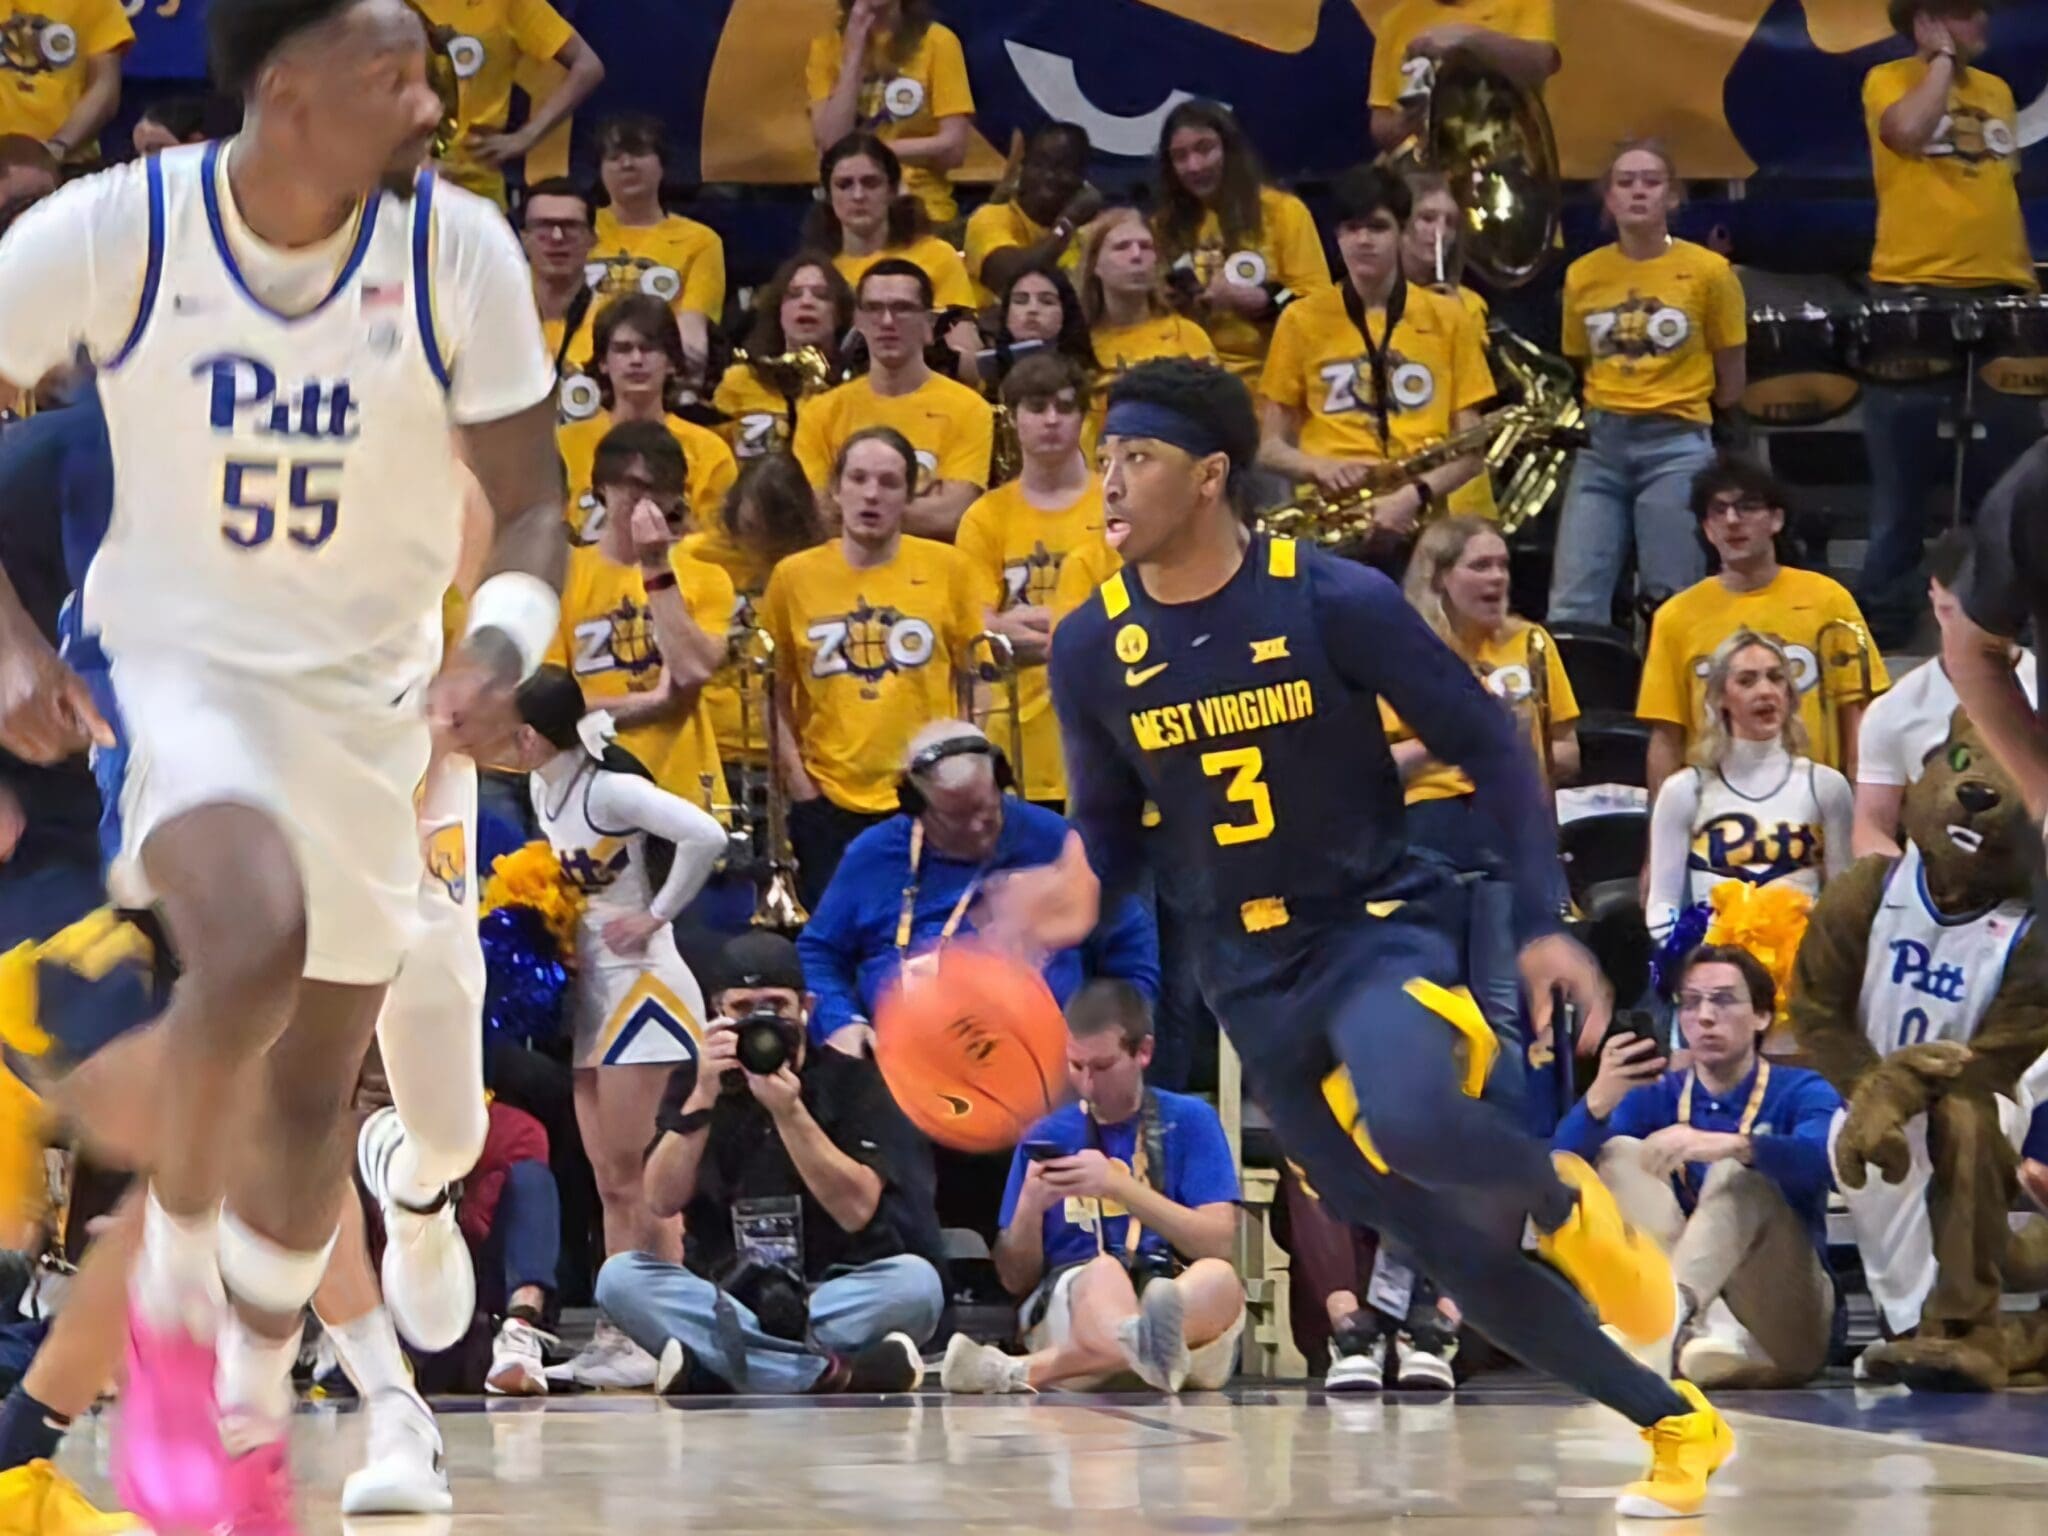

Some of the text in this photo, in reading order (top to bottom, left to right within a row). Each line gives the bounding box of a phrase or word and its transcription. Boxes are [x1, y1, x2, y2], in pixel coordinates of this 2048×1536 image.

[190, 353, 360, 440] Pitt
[220, 459, 344, 549] 55
[1130, 679, 1314, 751] WEST VIRGINIA
[1200, 745, 1276, 847] 3
[1691, 811, 1826, 870] Pitt
[1889, 939, 1967, 1003] Pitt
